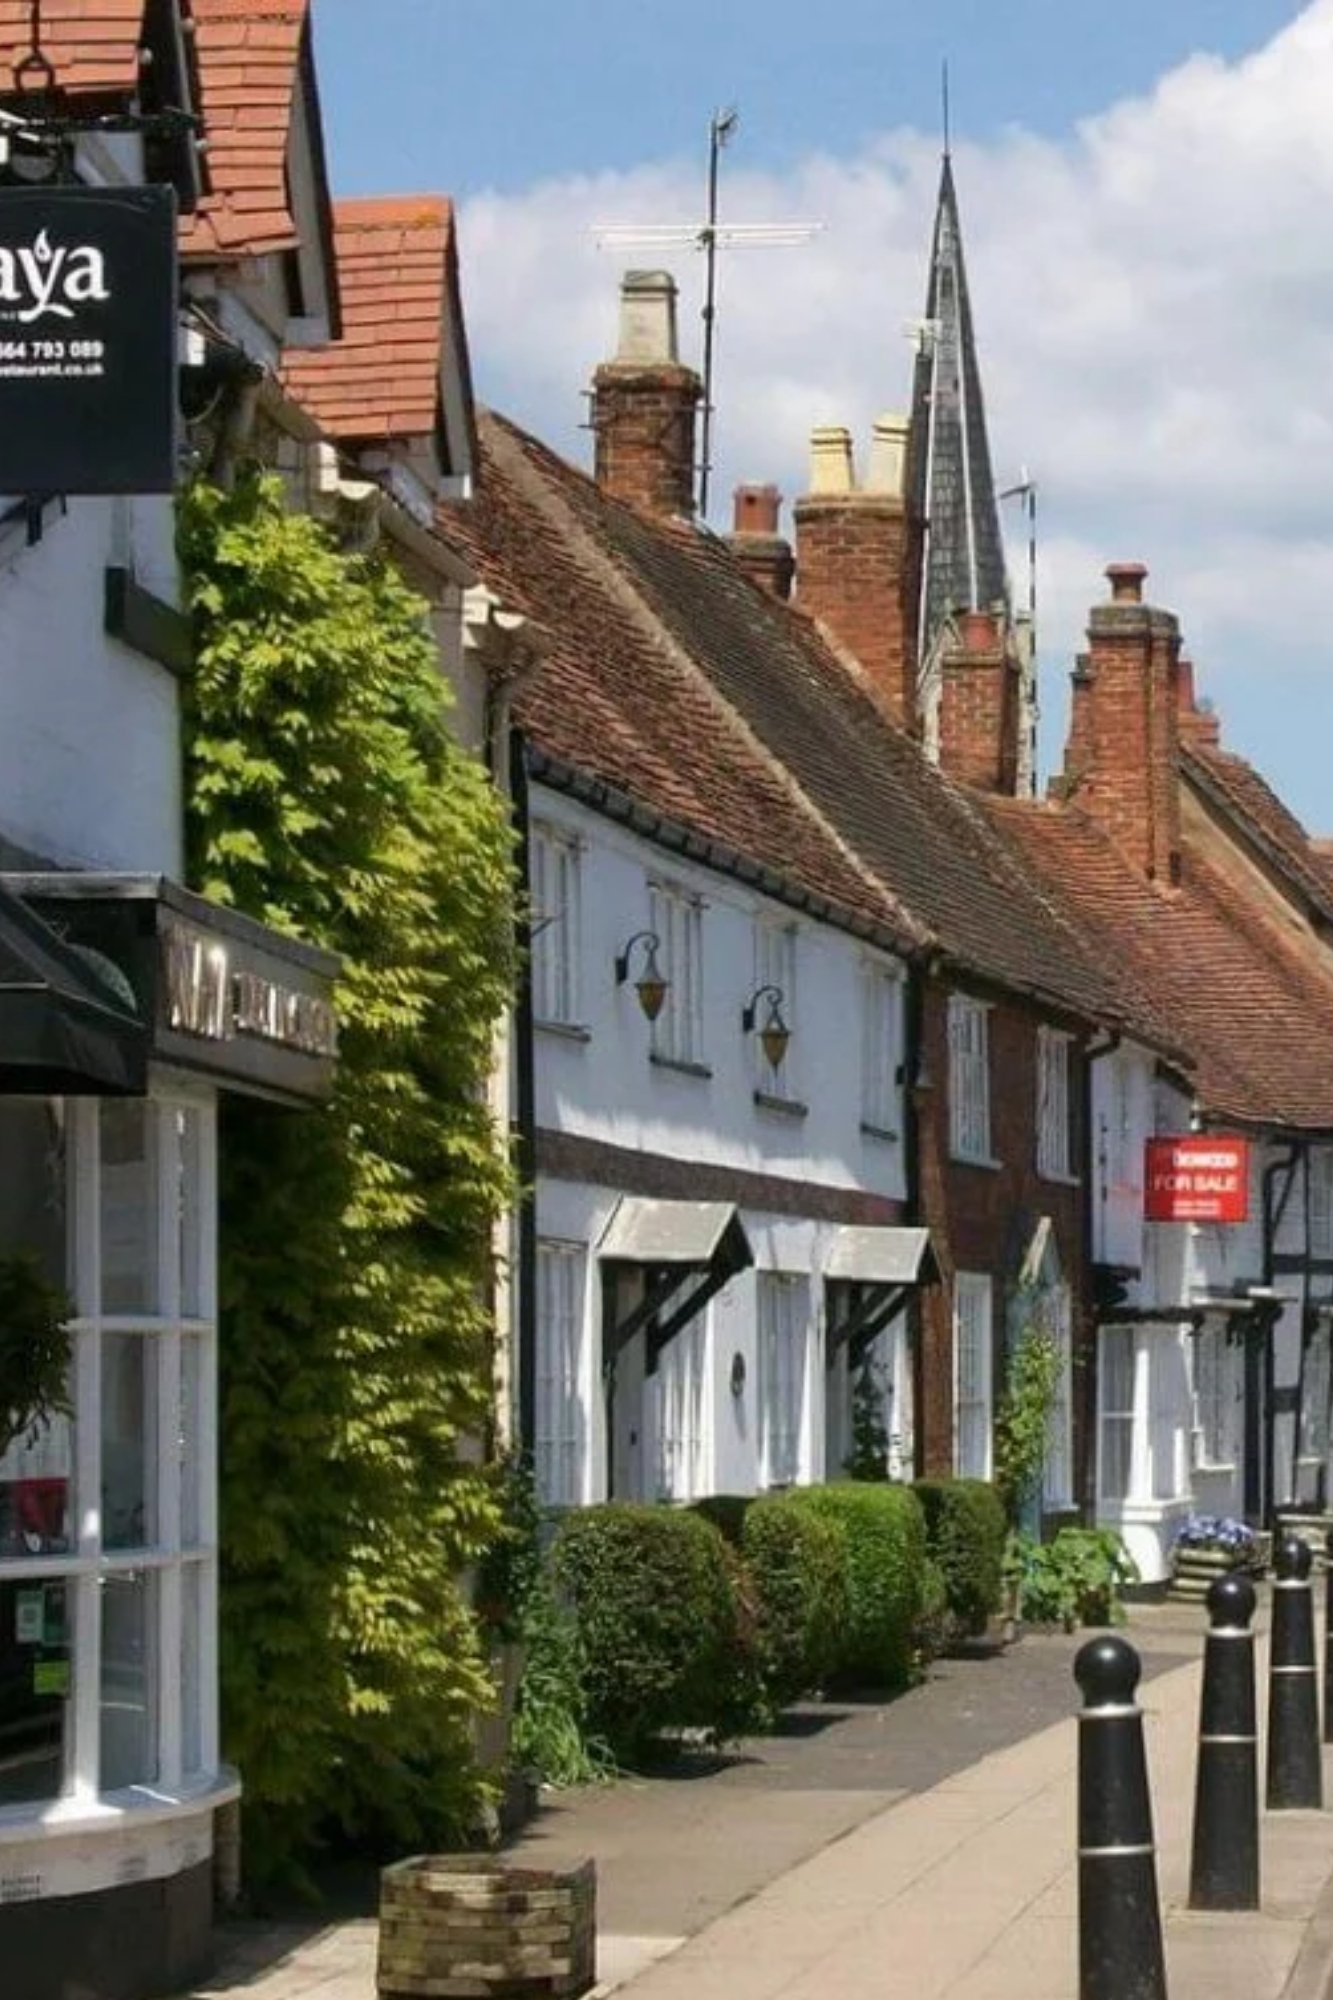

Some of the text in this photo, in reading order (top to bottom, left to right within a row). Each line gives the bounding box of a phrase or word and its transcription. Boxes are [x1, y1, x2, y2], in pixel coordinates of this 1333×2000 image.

[32, 340, 65, 360] 793
[69, 339, 104, 358] 089
[1154, 1174, 1237, 1192] FOR SALE
